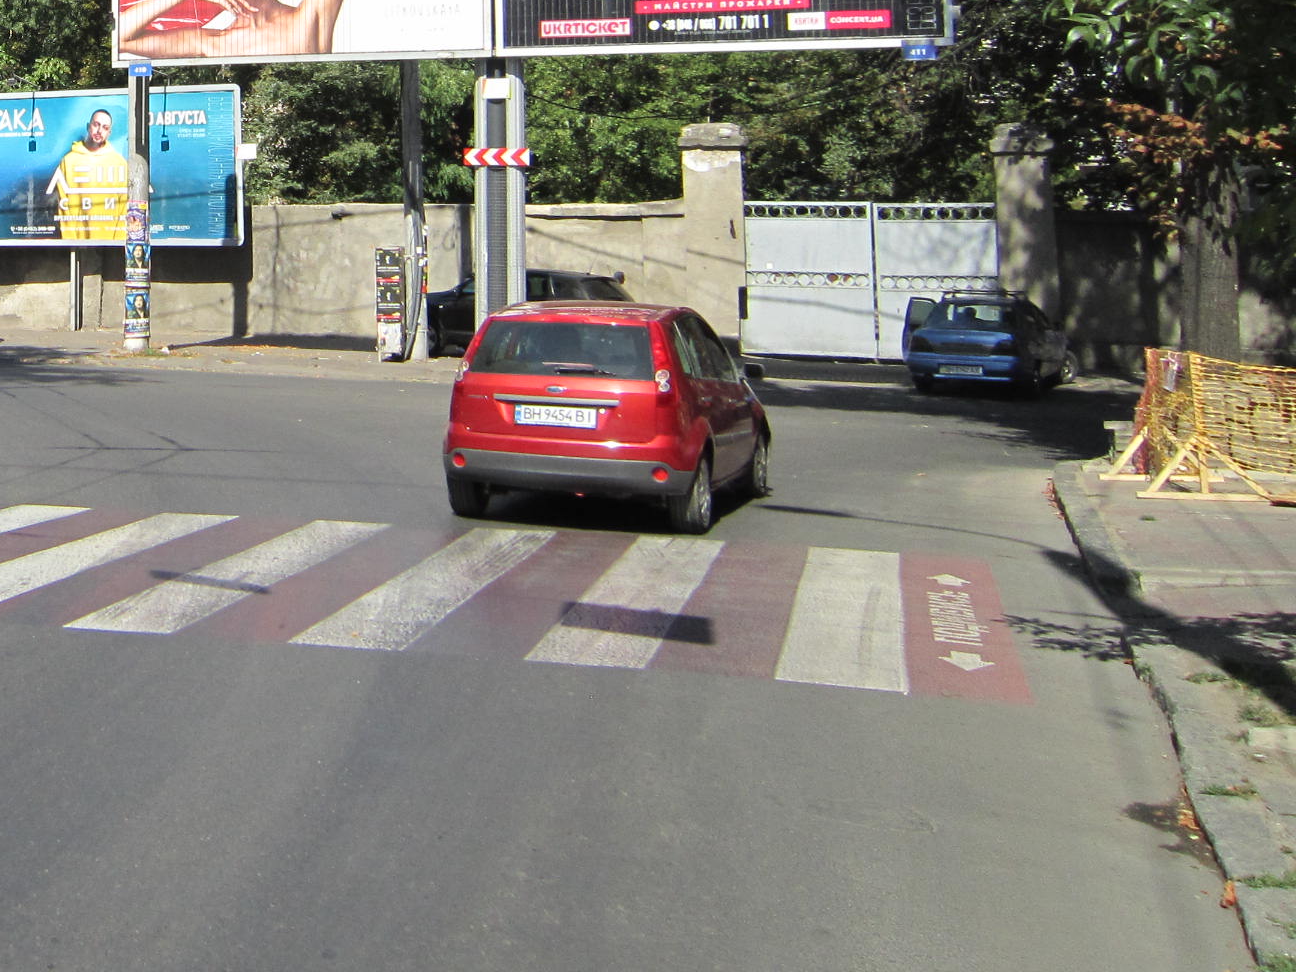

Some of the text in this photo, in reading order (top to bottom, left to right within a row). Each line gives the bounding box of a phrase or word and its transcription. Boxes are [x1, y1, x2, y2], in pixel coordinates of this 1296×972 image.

[653, 1, 713, 10] МАЙСТРИ
[718, 15, 737, 30] 701
[740, 15, 760, 30] 701
[762, 14, 769, 29] 1
[156, 110, 207, 125] АВГУСТА
[524, 407, 591, 423] BH 9454 BI
